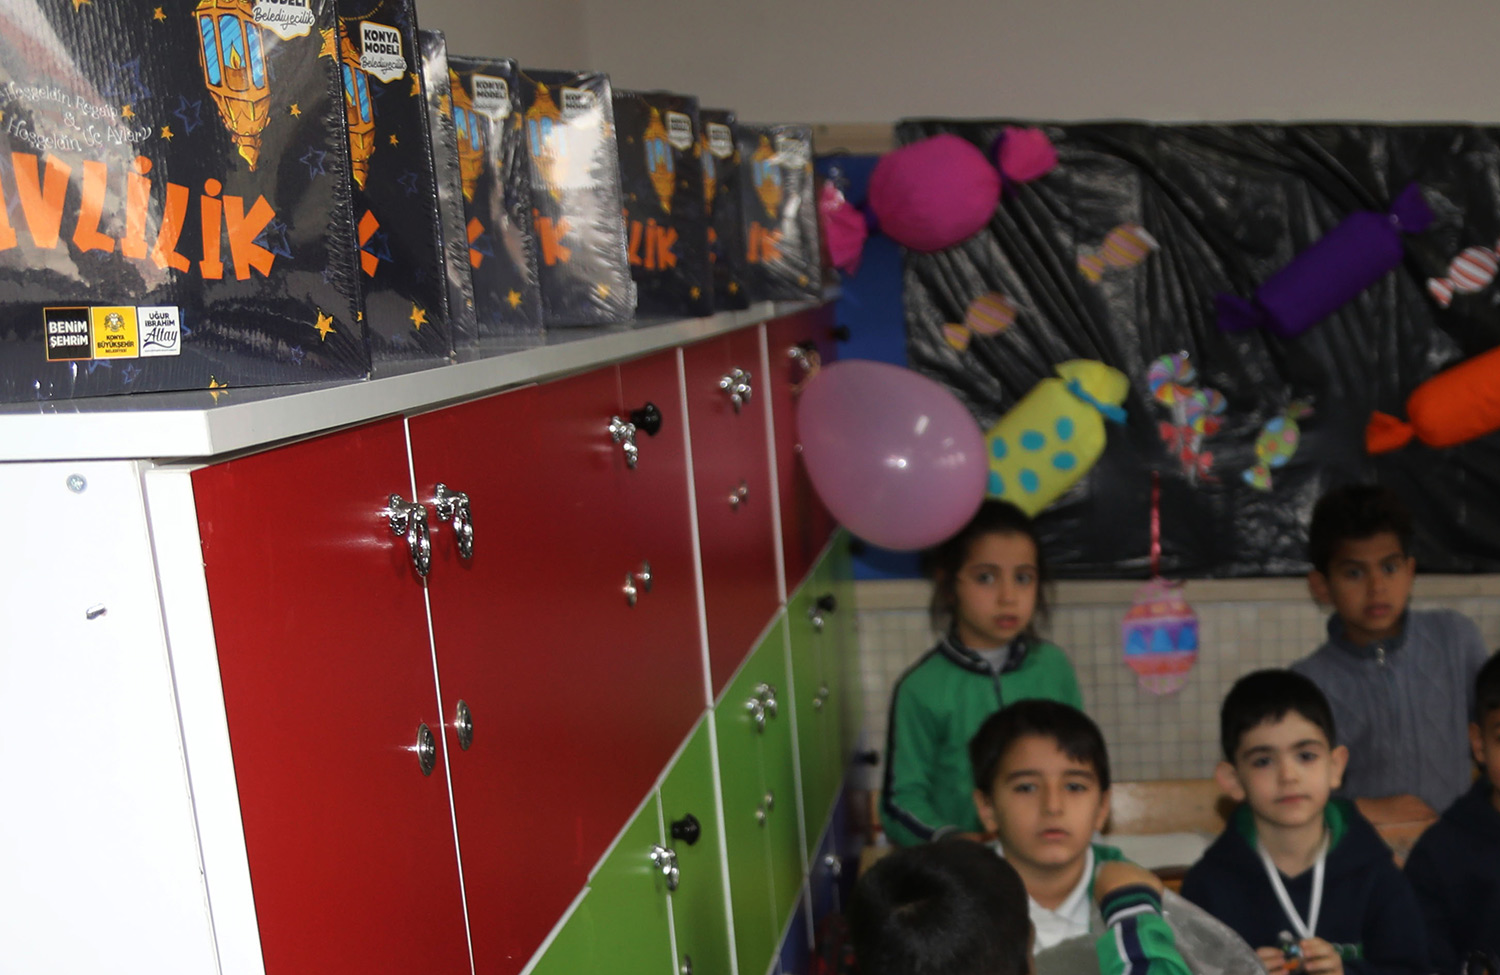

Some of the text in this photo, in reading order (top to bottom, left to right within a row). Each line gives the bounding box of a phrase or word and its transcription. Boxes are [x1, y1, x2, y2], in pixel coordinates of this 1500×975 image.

[254, 7, 314, 30] Belediyecilik
[364, 29, 399, 44] KONYA
[149, 311, 170, 320] UĞUR
[49, 320, 88, 335] BENİM
[50, 334, 89, 349] ŞEHRİM
[143, 327, 178, 348] Altay
